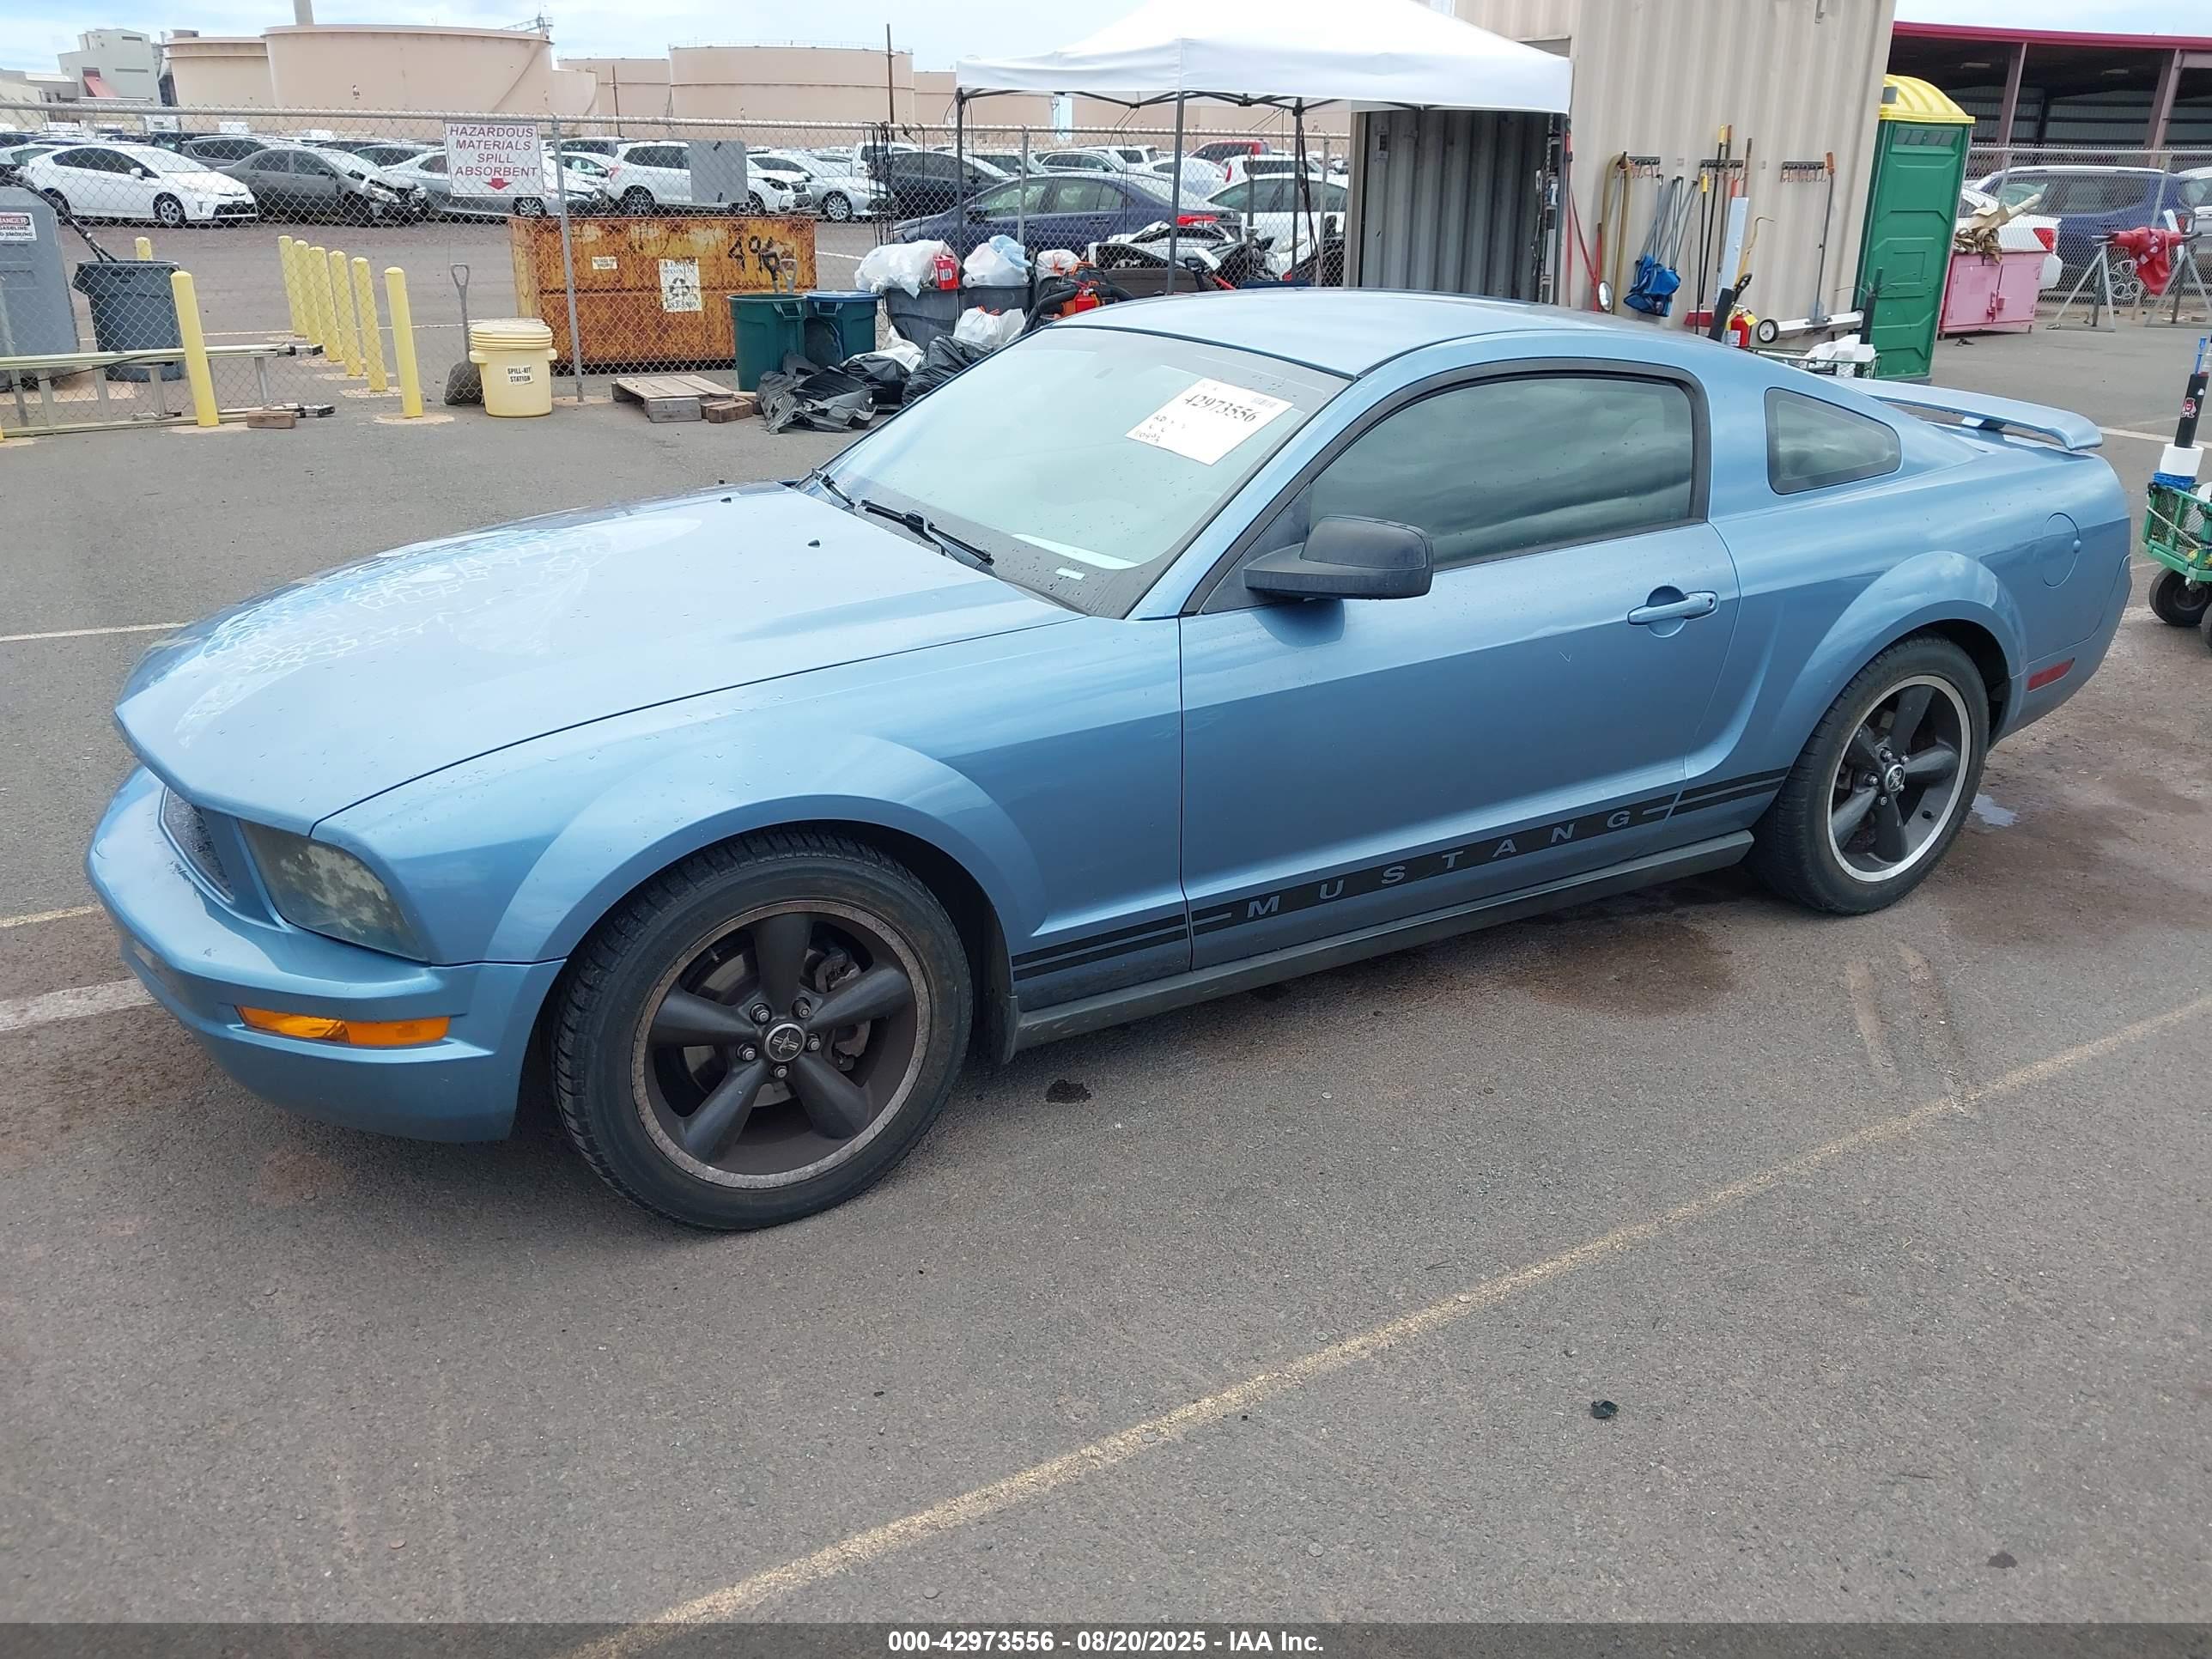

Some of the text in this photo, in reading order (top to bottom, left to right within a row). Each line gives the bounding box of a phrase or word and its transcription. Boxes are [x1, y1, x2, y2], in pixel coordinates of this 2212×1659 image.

[449, 126, 533, 137] HAZARDOUS
[456, 140, 531, 150] MATERIALS
[477, 153, 514, 163] SPILL
[455, 166, 538, 177] ABSORBENT
[1183, 393, 1261, 422] 42973556
[1246, 810, 1632, 920] MUSTANG
